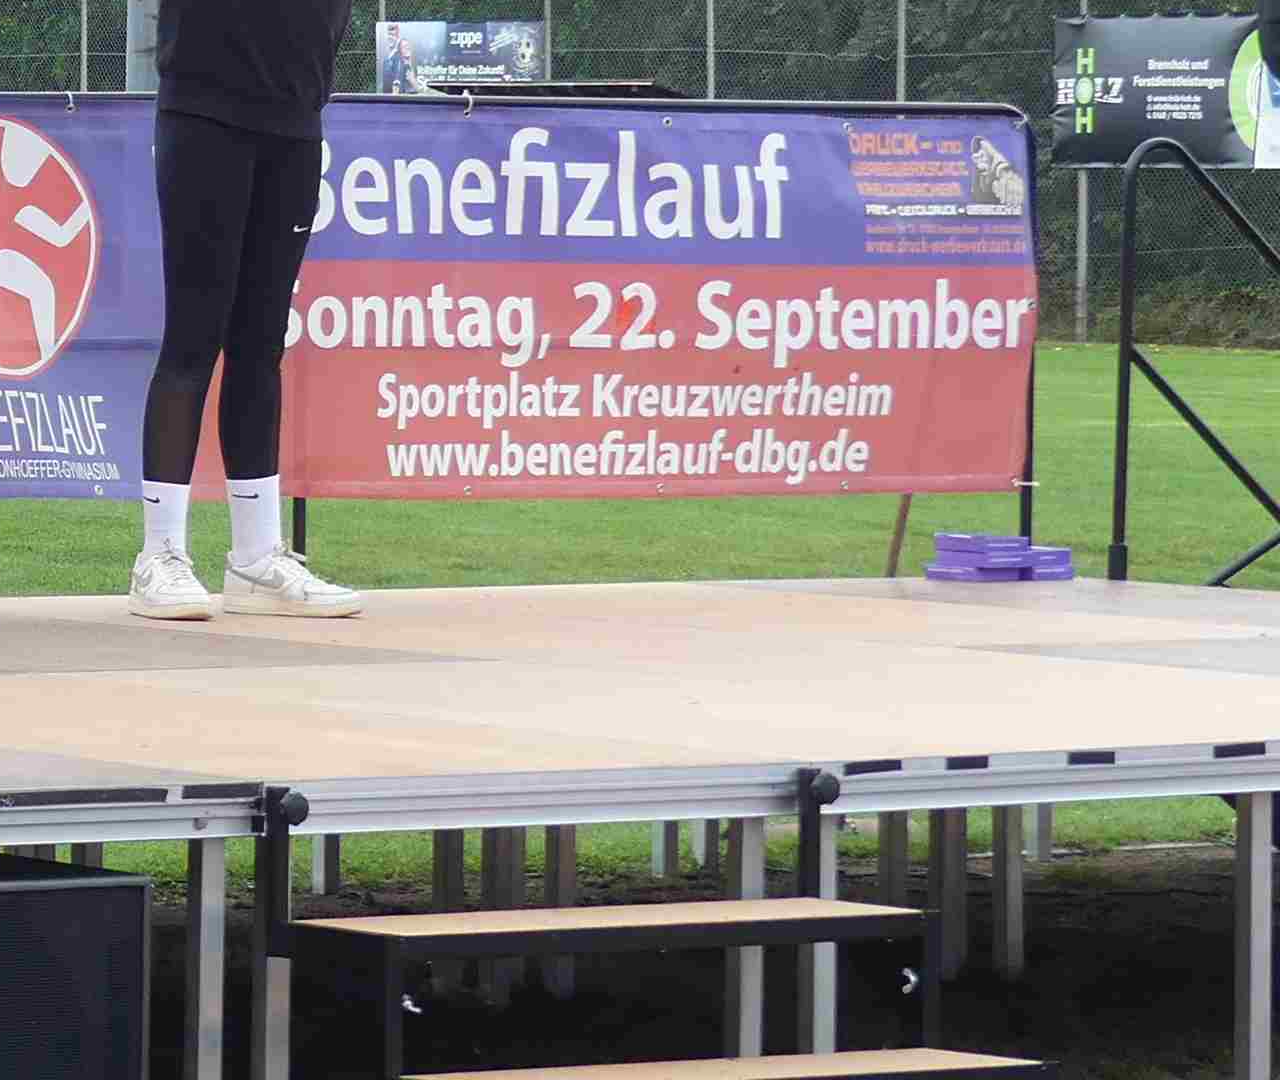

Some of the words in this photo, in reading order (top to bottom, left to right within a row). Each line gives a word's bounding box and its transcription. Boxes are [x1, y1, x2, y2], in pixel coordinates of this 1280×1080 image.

[568, 280, 676, 351] 22.
[695, 278, 1037, 369] September
[376, 372, 582, 430] Sportplatz
[591, 372, 893, 420] Kreuzwertheim
[386, 428, 871, 486] www.benefizlauf-dbg.de
